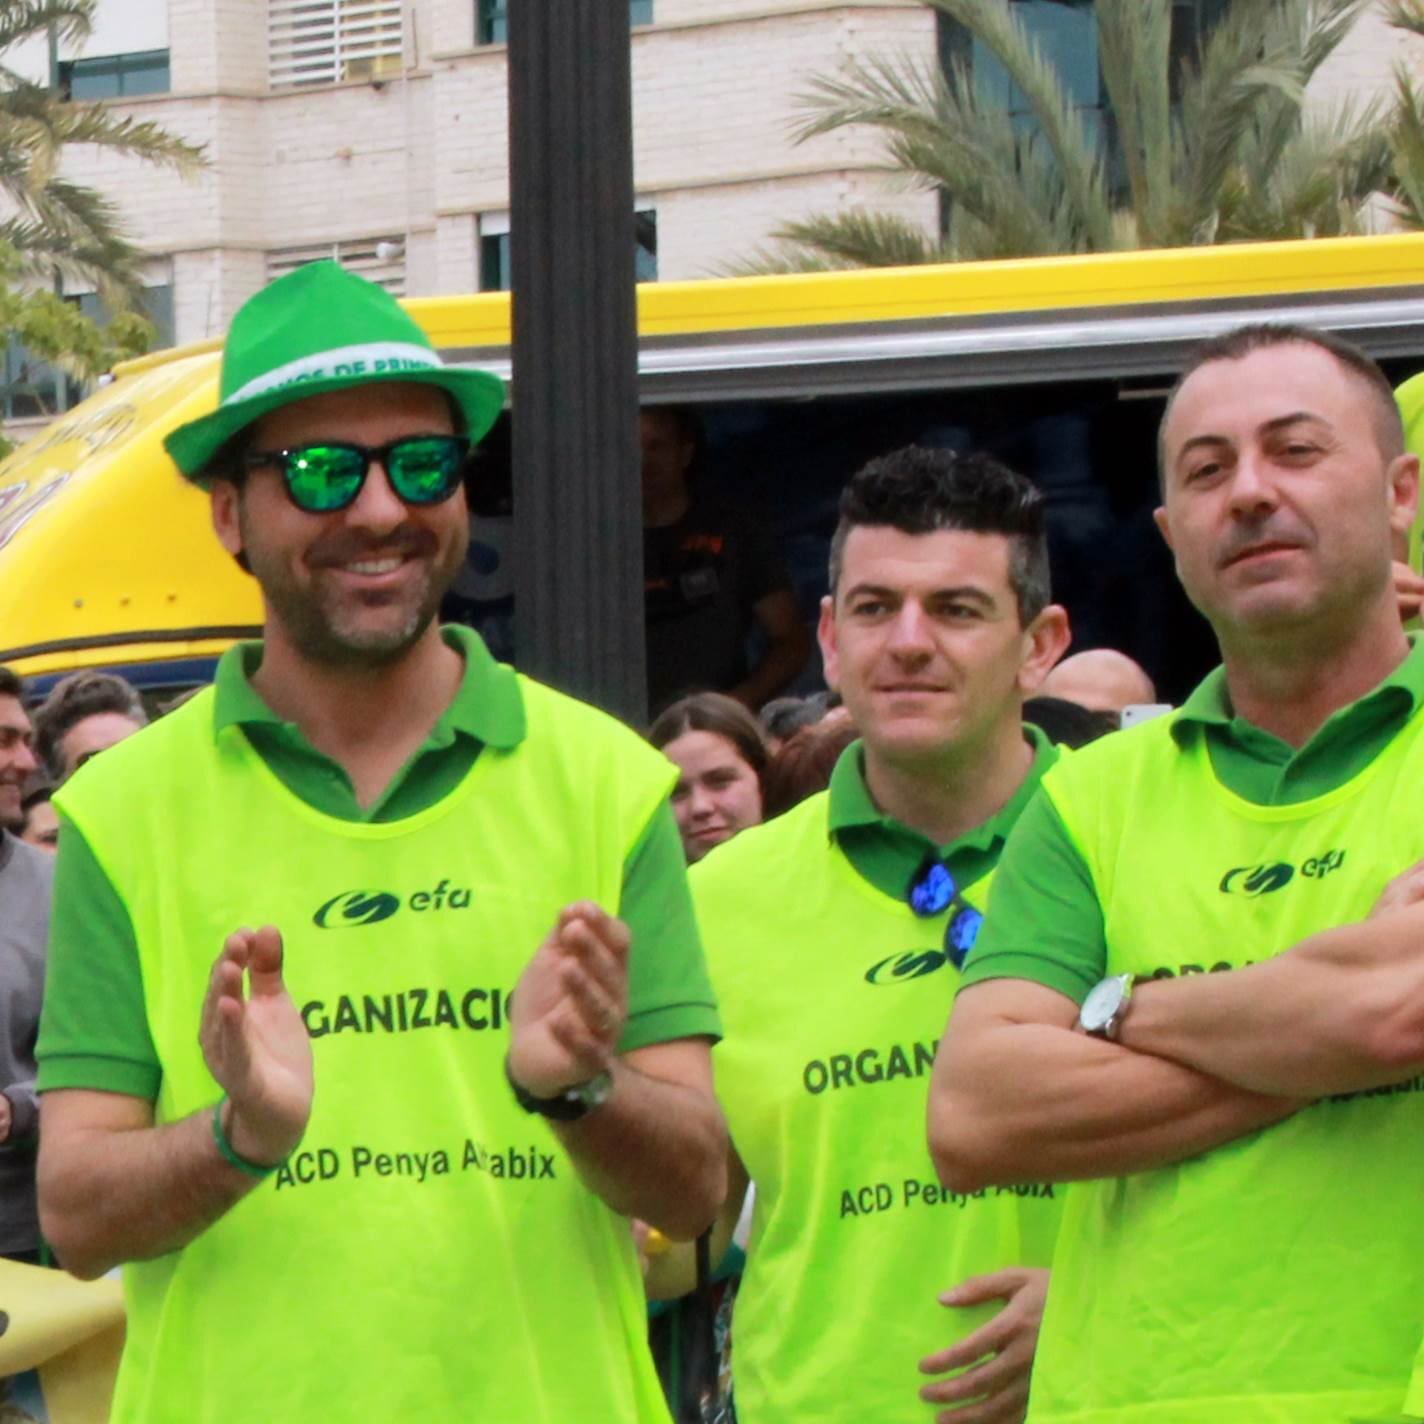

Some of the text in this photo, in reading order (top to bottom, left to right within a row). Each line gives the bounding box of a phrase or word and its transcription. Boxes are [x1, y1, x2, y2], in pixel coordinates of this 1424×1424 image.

[408, 879, 473, 912] efa
[274, 1148, 340, 1191] ACD
[351, 1146, 450, 1183] Penya
[839, 1182, 893, 1219] ACD
